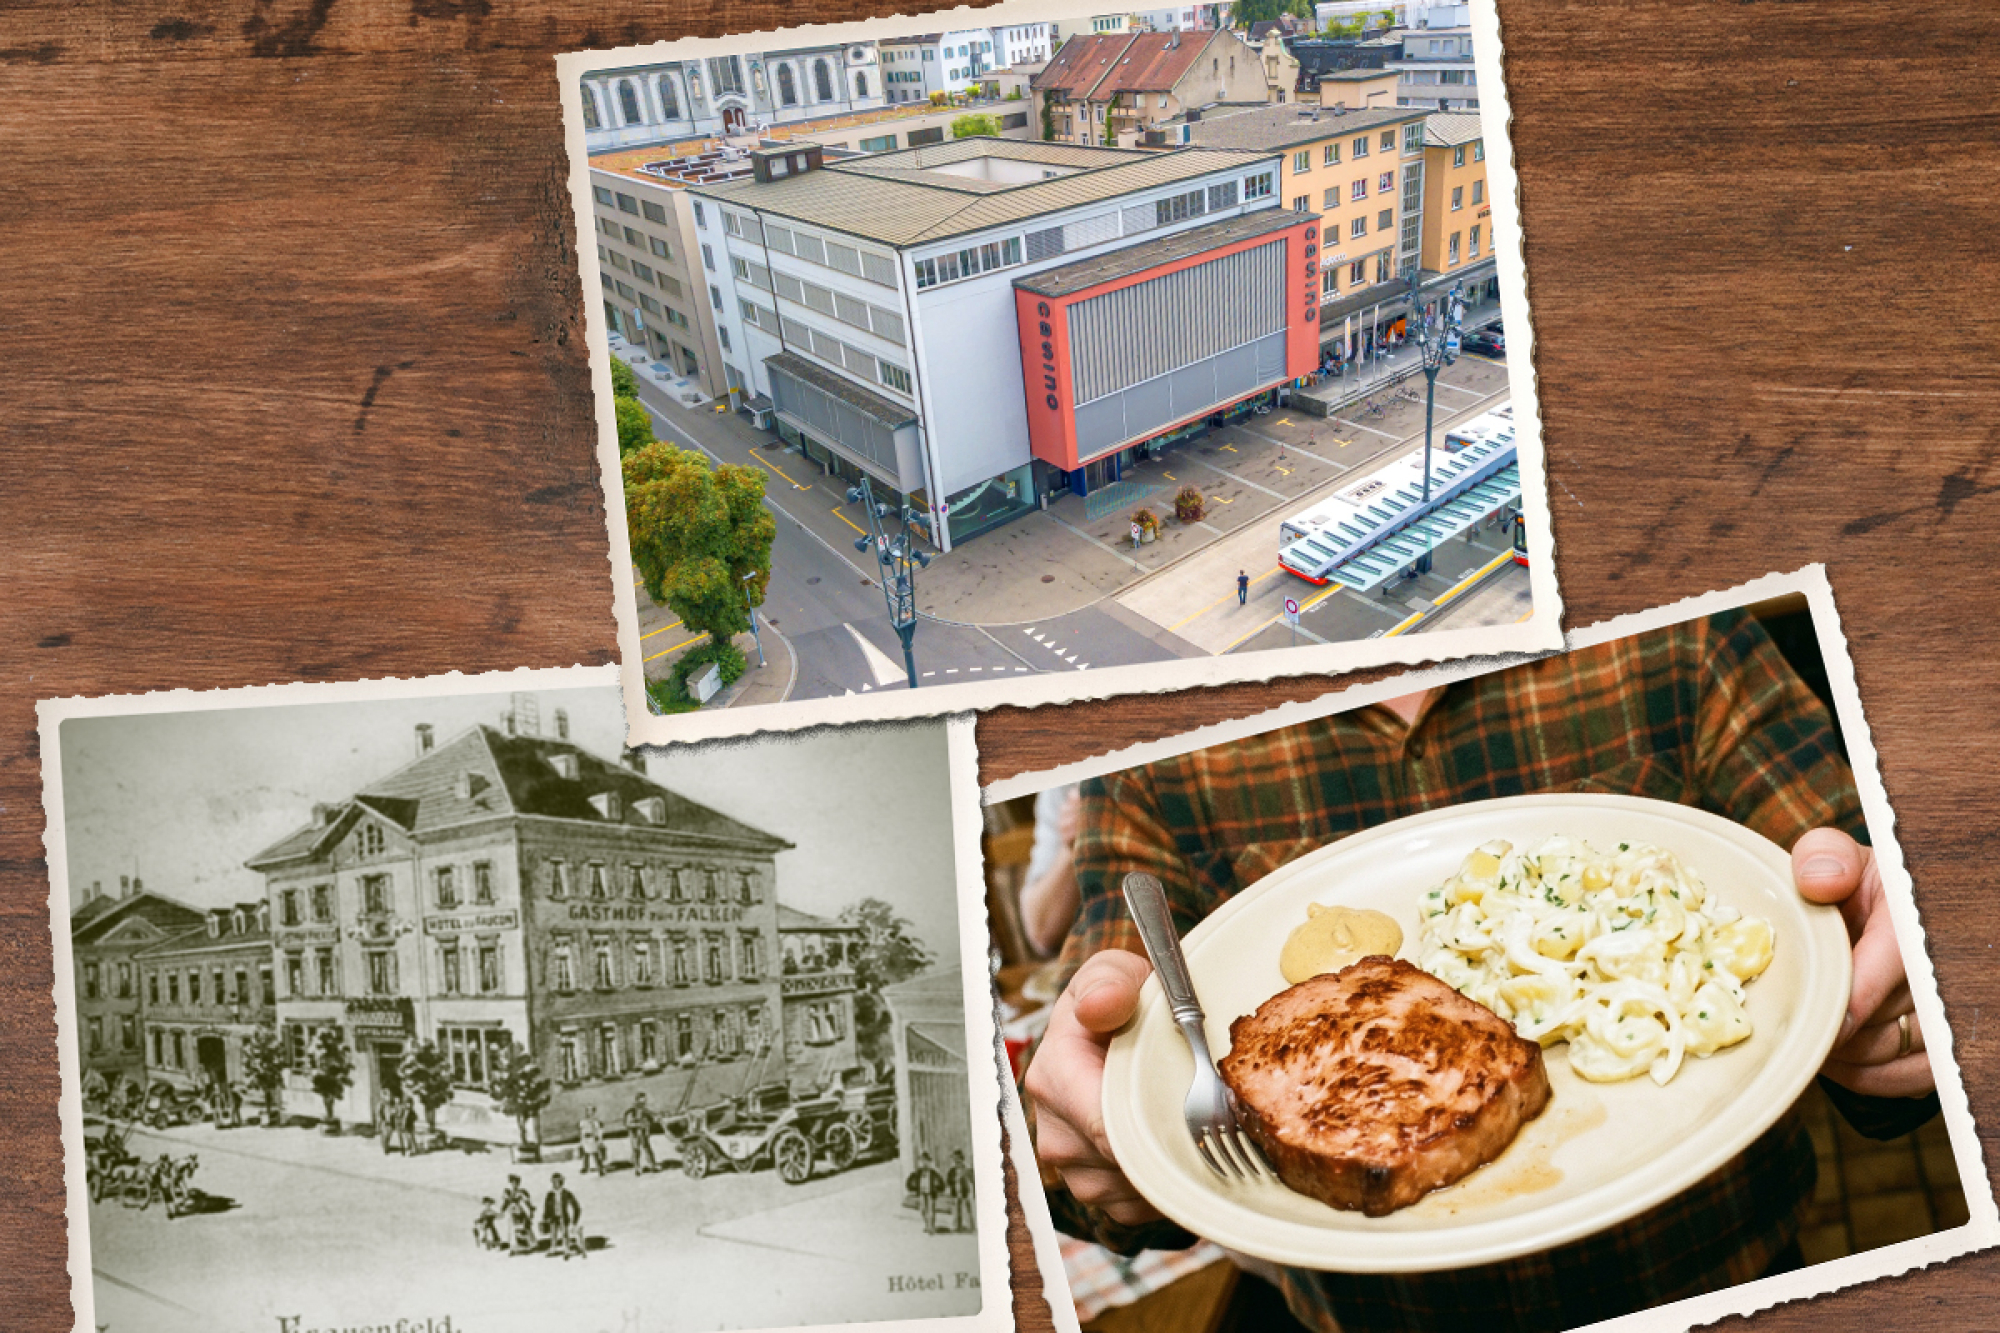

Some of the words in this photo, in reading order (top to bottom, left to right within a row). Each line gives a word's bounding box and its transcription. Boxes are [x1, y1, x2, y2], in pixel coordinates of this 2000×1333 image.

[1305, 226, 1317, 322] casino
[1037, 301, 1058, 410] casino
[569, 904, 645, 921] GASTHOF
[677, 906, 743, 923] FALKEN
[887, 1272, 944, 1293] Hôtel
